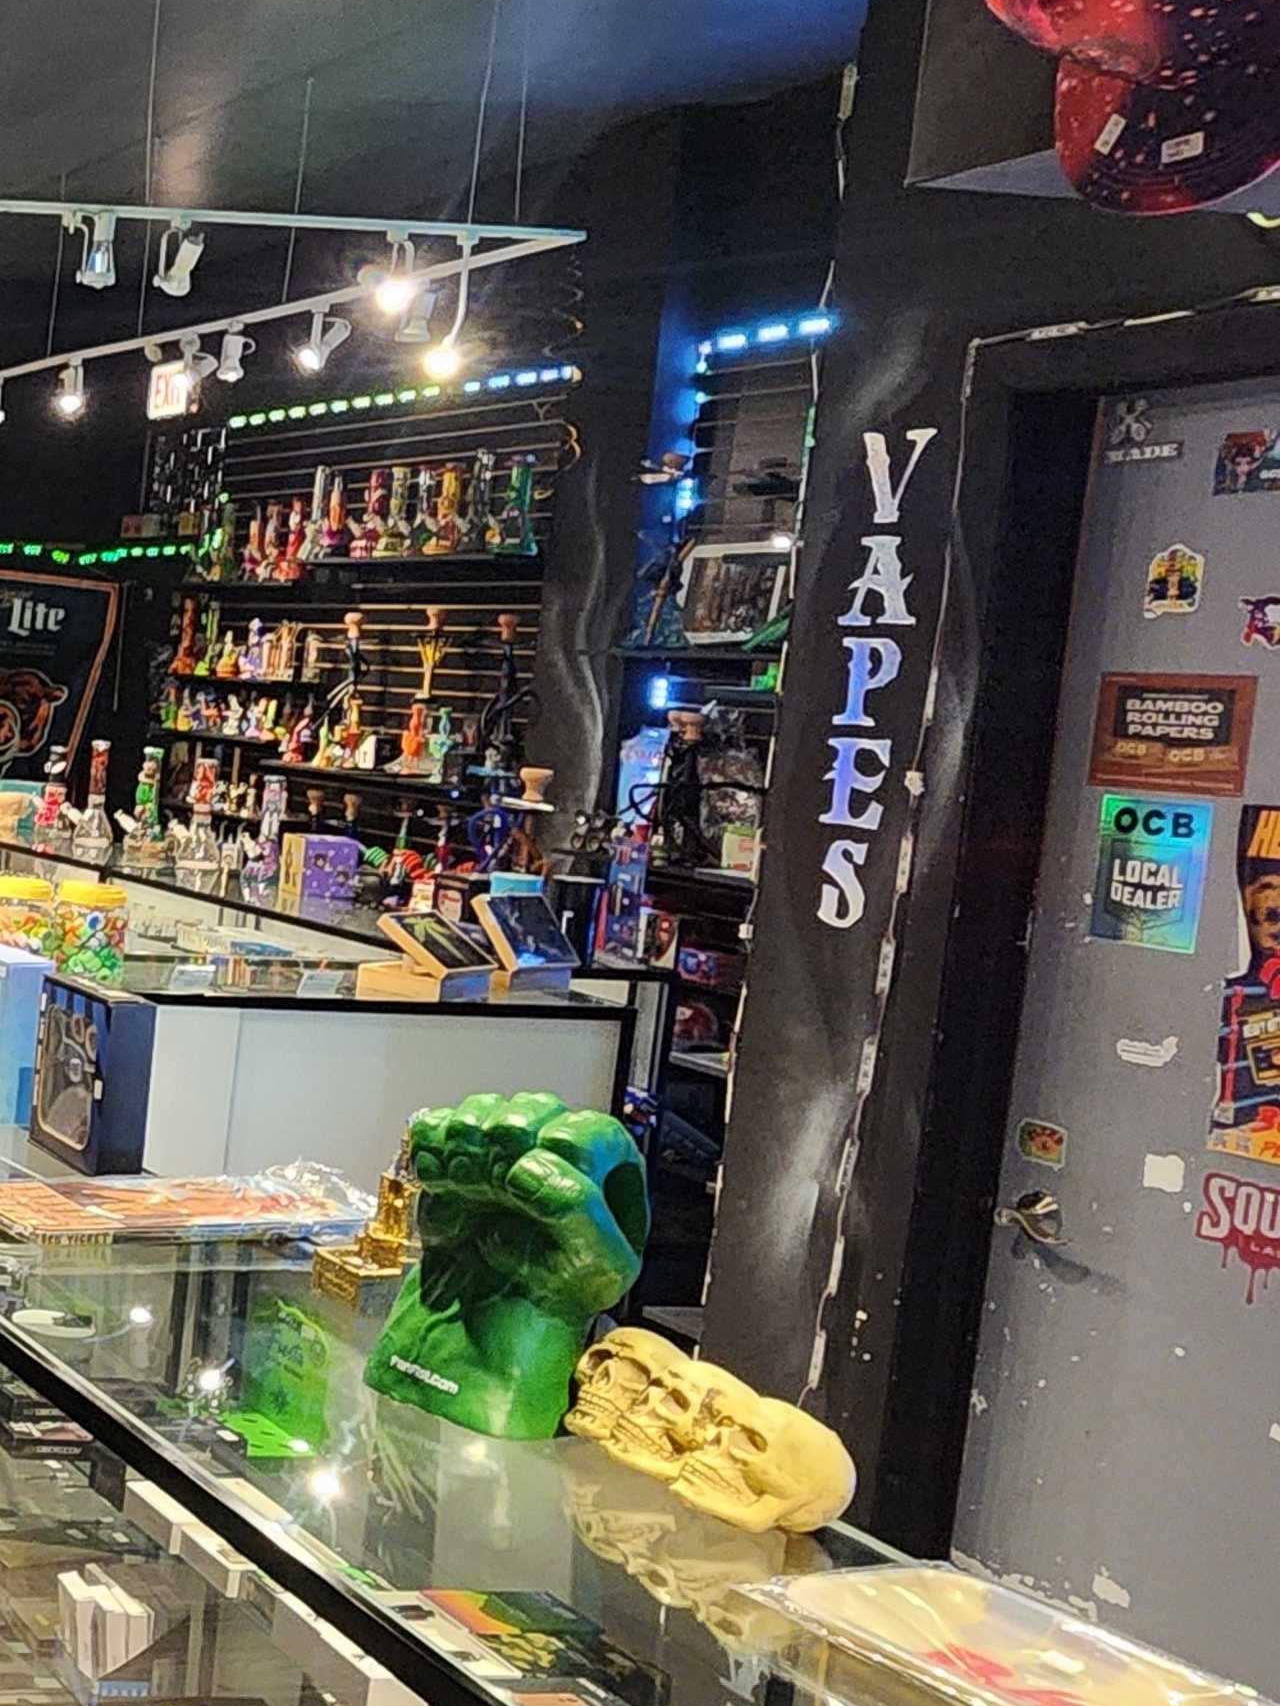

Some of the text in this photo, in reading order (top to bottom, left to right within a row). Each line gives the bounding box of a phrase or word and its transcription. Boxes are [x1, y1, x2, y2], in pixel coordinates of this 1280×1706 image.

[7, 597, 67, 637] Lite
[815, 427, 940, 930] VAPES
[1125, 698, 1225, 714] BAMBOO
[1125, 713, 1220, 726] ROLLING
[1128, 724, 1215, 740] PAPERS
[1168, 748, 1206, 762] OCB
[1114, 807, 1196, 839] OCB
[1112, 859, 1184, 889] LOCAL
[1110, 882, 1184, 910] DEALER
